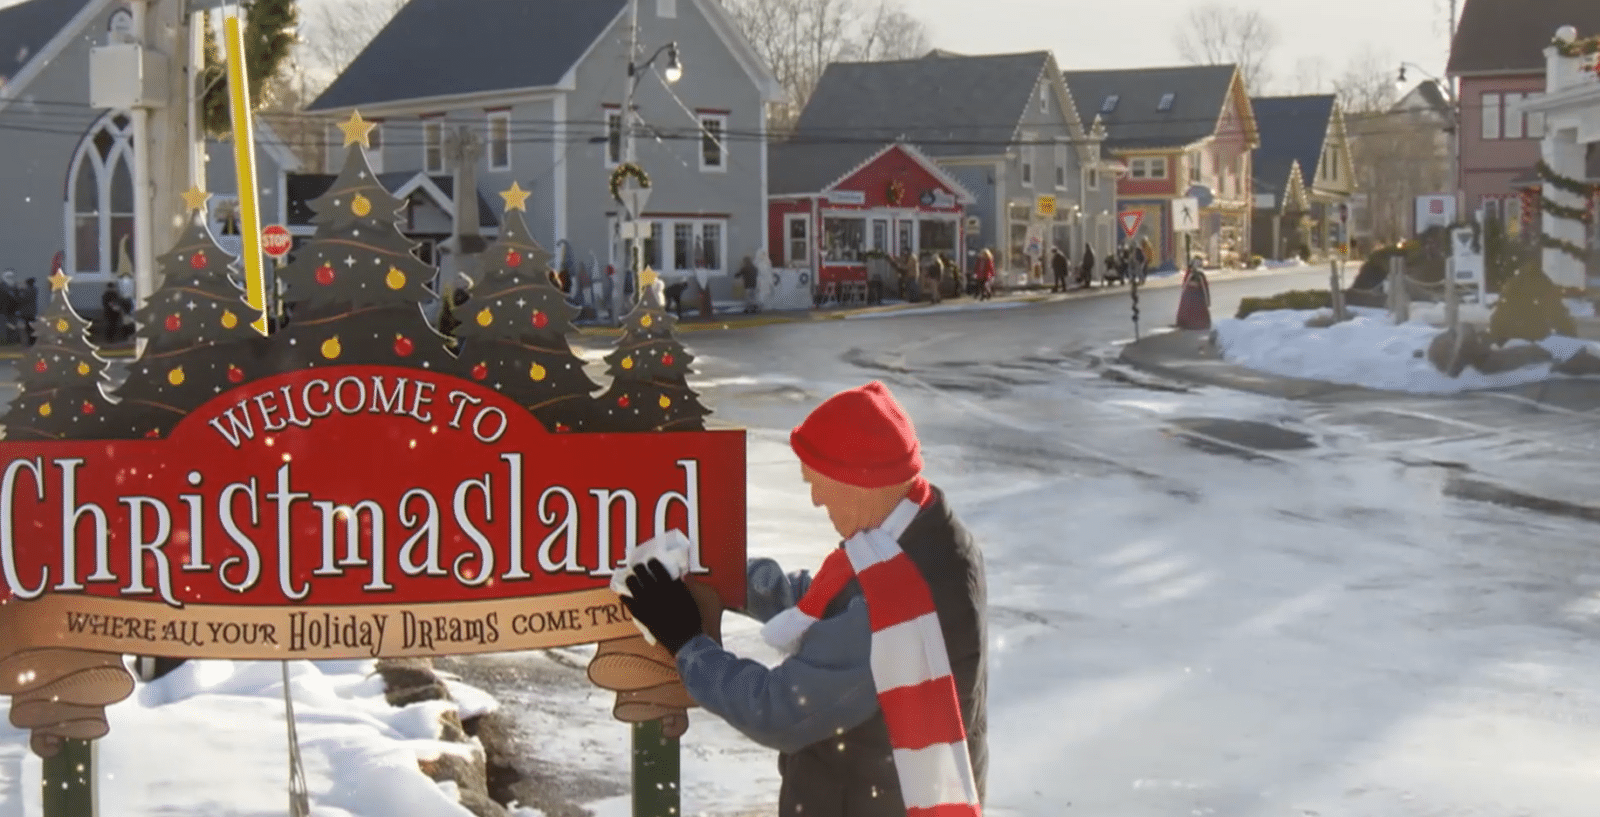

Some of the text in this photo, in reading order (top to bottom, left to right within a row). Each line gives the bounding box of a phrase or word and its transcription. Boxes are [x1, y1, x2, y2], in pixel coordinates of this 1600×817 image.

[261, 233, 289, 247] STOP
[208, 376, 508, 447] WELCOME TO
[66, 611, 156, 641] WHERE
[161, 620, 203, 646] ALL
[207, 622, 278, 645] YOUR
[288, 611, 388, 657] Holiday
[512, 611, 582, 636] COME
[584, 603, 632, 626] TRU
